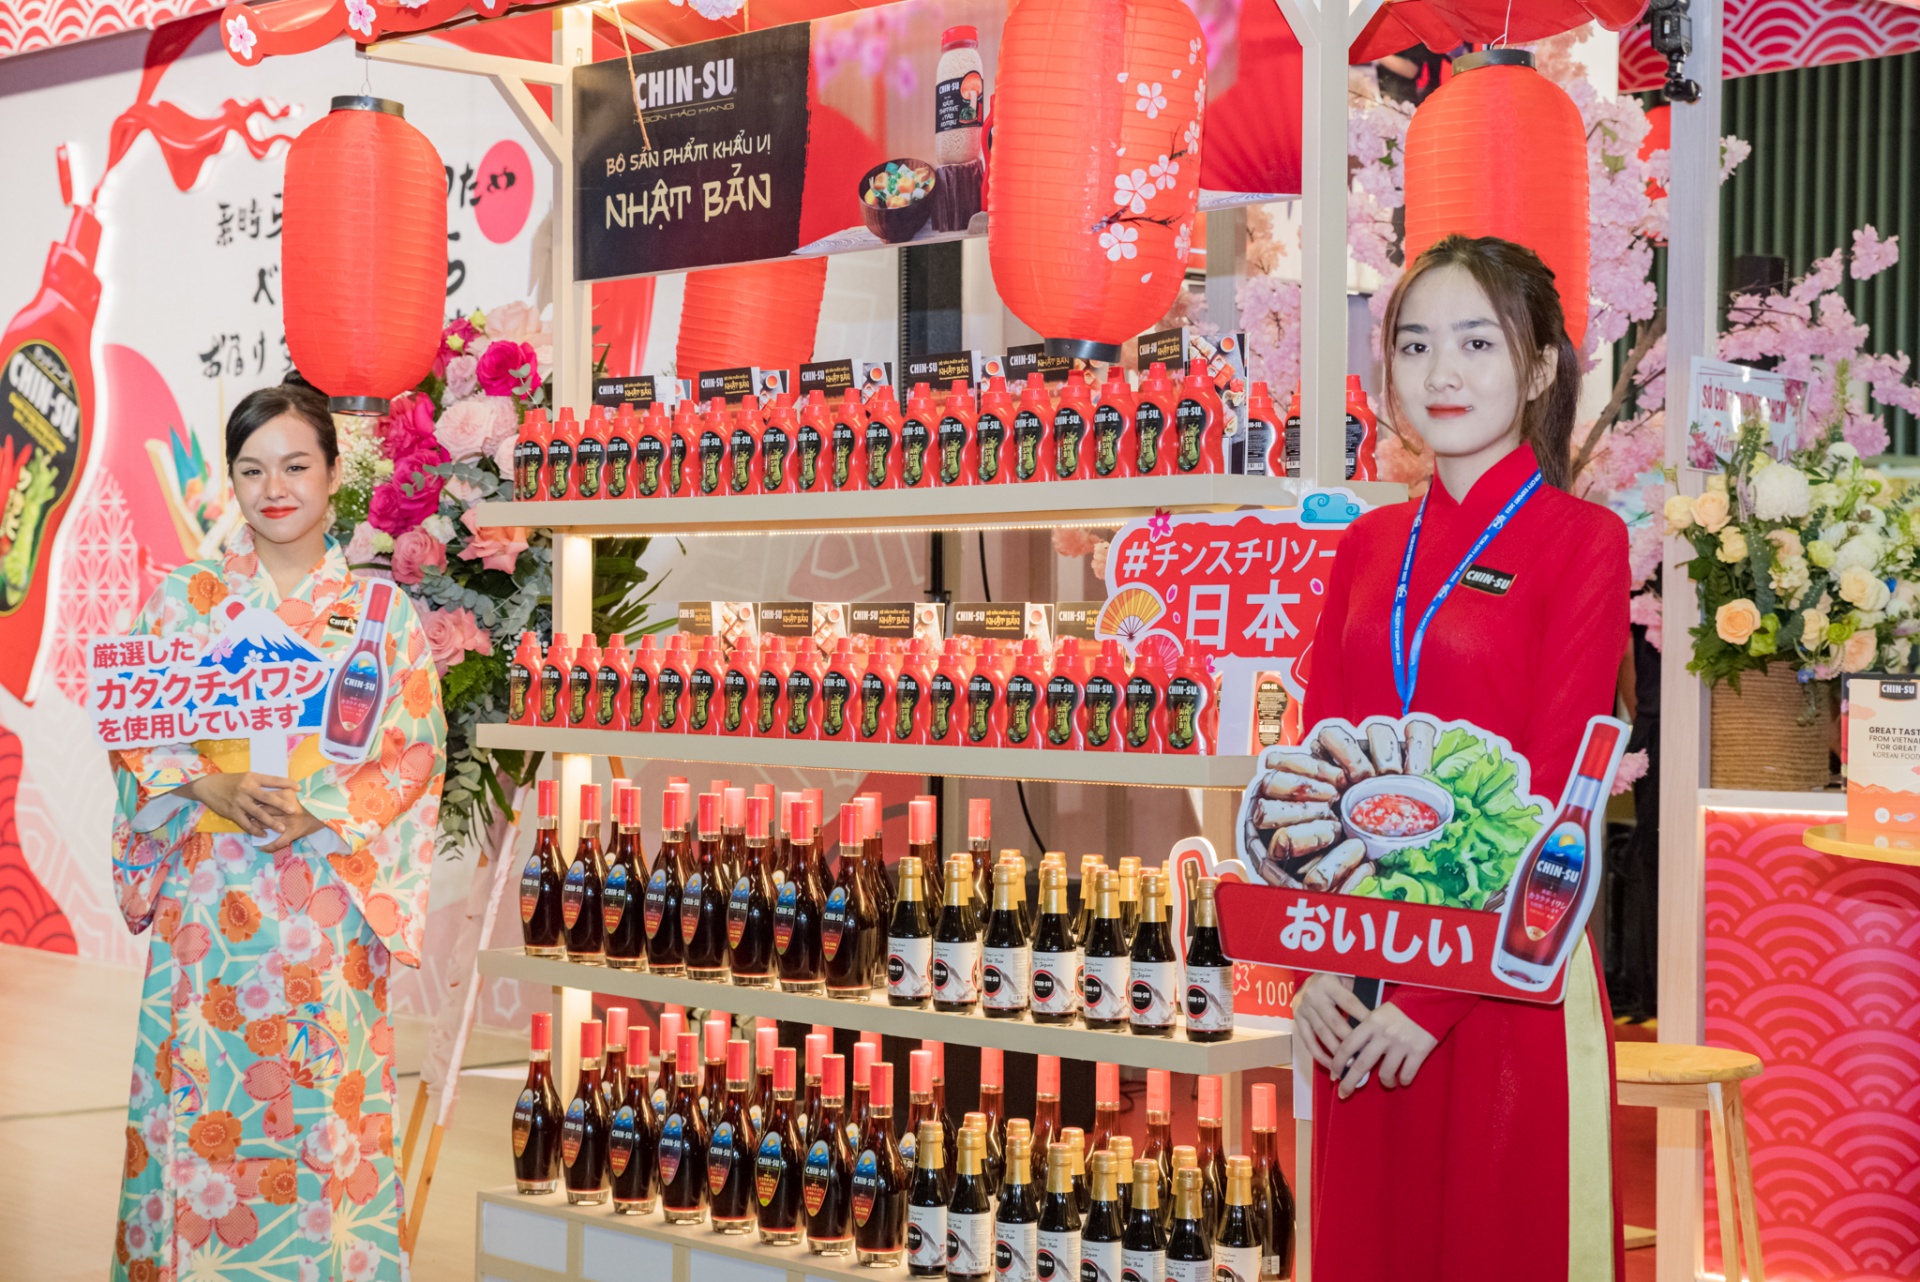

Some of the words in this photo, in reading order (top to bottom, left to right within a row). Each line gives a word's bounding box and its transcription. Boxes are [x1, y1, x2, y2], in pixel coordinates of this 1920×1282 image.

[635, 58, 735, 110] CHIN-SU
[606, 153, 626, 177] BỘ
[663, 137, 708, 166] PHẨM
[713, 129, 752, 159] KHẨU
[756, 133, 771, 155] VỊ
[605, 178, 691, 230] NHẬT
[702, 163, 771, 223] BẢN
[1010, 353, 1036, 366] CHIN-SU
[910, 362, 937, 374] CHIN-SU
[802, 370, 824, 382] CHIN-SU
[701, 377, 724, 389] CHIN-SU
[598, 384, 624, 395] CHIN-SU
[9, 352, 79, 440] CHIN-SU
[1122, 536, 1338, 578] #チンスチリソー
[1465, 570, 1511, 590] CHIN-SU
[853, 610, 878, 621] CHIN-SU
[956, 611, 985, 621] CHIN-SU
[1059, 611, 1086, 621] CHIN-SU
[1186, 579, 1301, 651] 日本
[93, 637, 195, 669] 厳選した
[96, 664, 325, 711] カタクチイワシ
[344, 678, 376, 691] CHIN-SU
[1048, 684, 1075, 693] CHIN-SU
[1086, 684, 1114, 694] CHIN-SU
[1168, 685, 1199, 695] CHIN-SU
[1881, 684, 1915, 694] CHIN-SU
[98, 704, 300, 743] を使用しています
[1869, 727, 1897, 735] GREAT
[1869, 735, 1890, 743] FROM
[1536, 860, 1579, 883] CHIN-SU
[1279, 898, 1474, 968] おいしい
[758, 1157, 780, 1167] CHIN-SU
[805, 1166, 828, 1176] CHIN-SU
[854, 1176, 876, 1186] CHIN-SU
